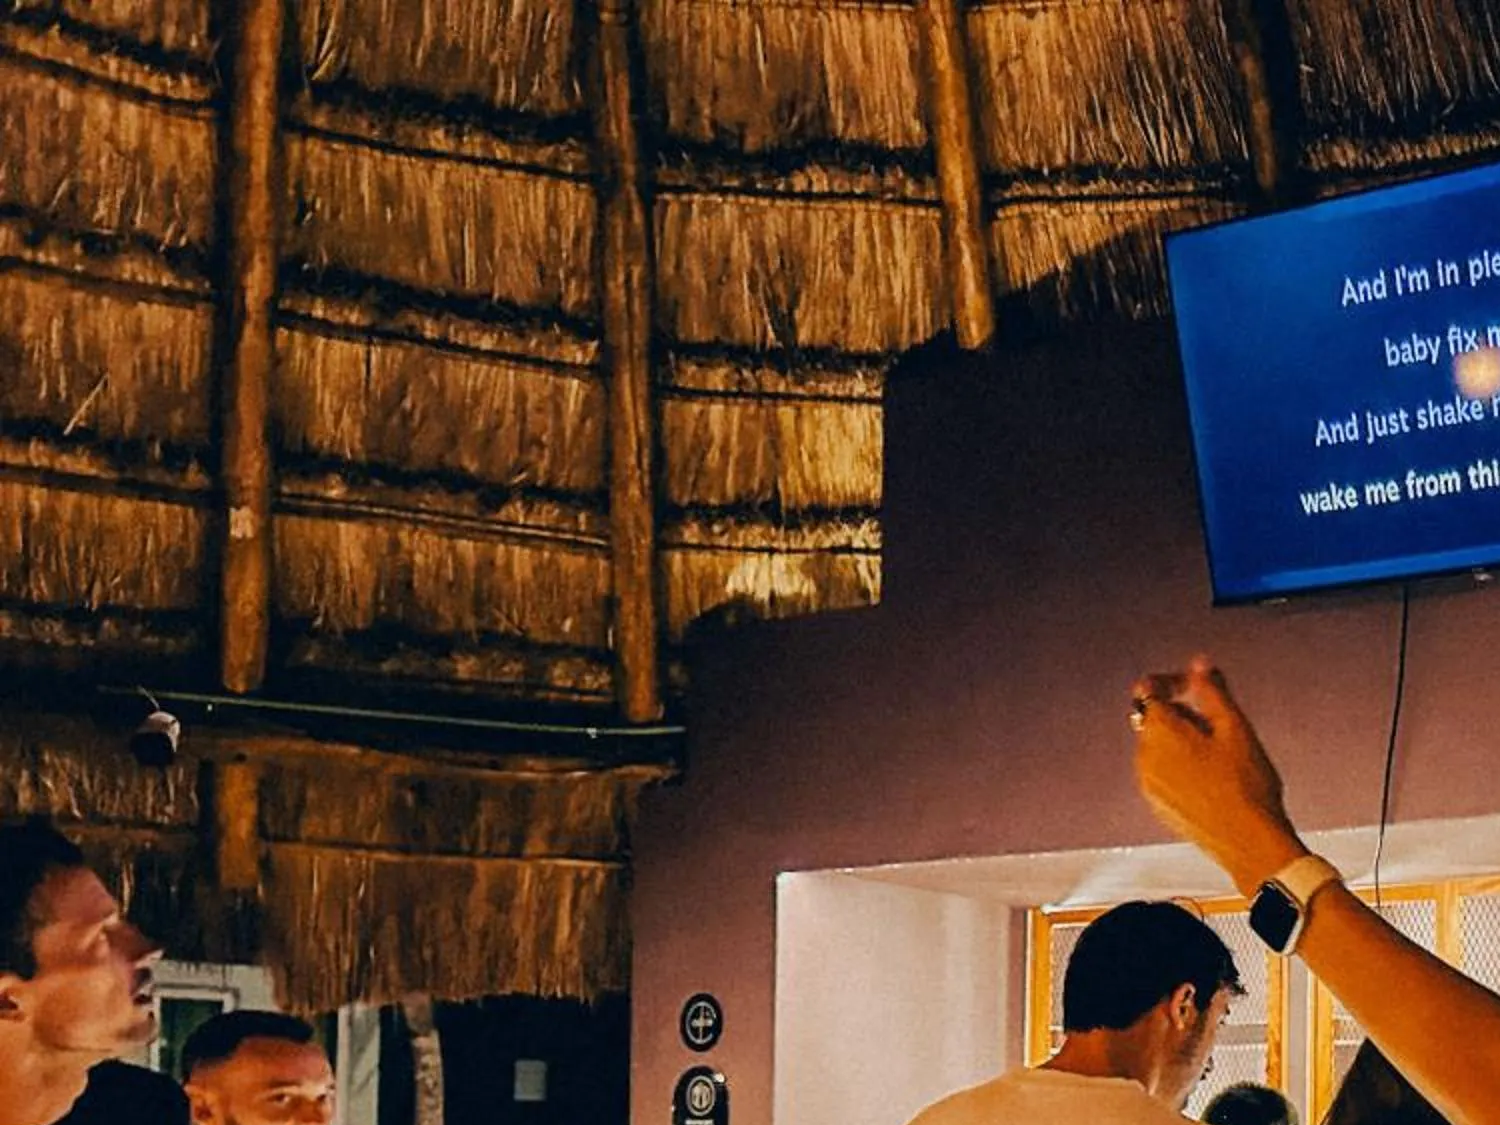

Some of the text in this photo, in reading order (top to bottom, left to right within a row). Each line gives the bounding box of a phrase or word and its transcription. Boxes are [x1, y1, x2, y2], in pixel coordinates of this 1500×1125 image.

[1342, 269, 1387, 306] And
[1394, 264, 1430, 296] I'm
[1437, 258, 1460, 287] in
[1384, 333, 1440, 367] baby
[1447, 324, 1479, 356] fix
[1315, 412, 1359, 447] And
[1366, 408, 1410, 445] just
[1416, 394, 1484, 430] shake
[1300, 482, 1358, 516] wake
[1365, 478, 1400, 505] me
[1405, 468, 1461, 500] from
